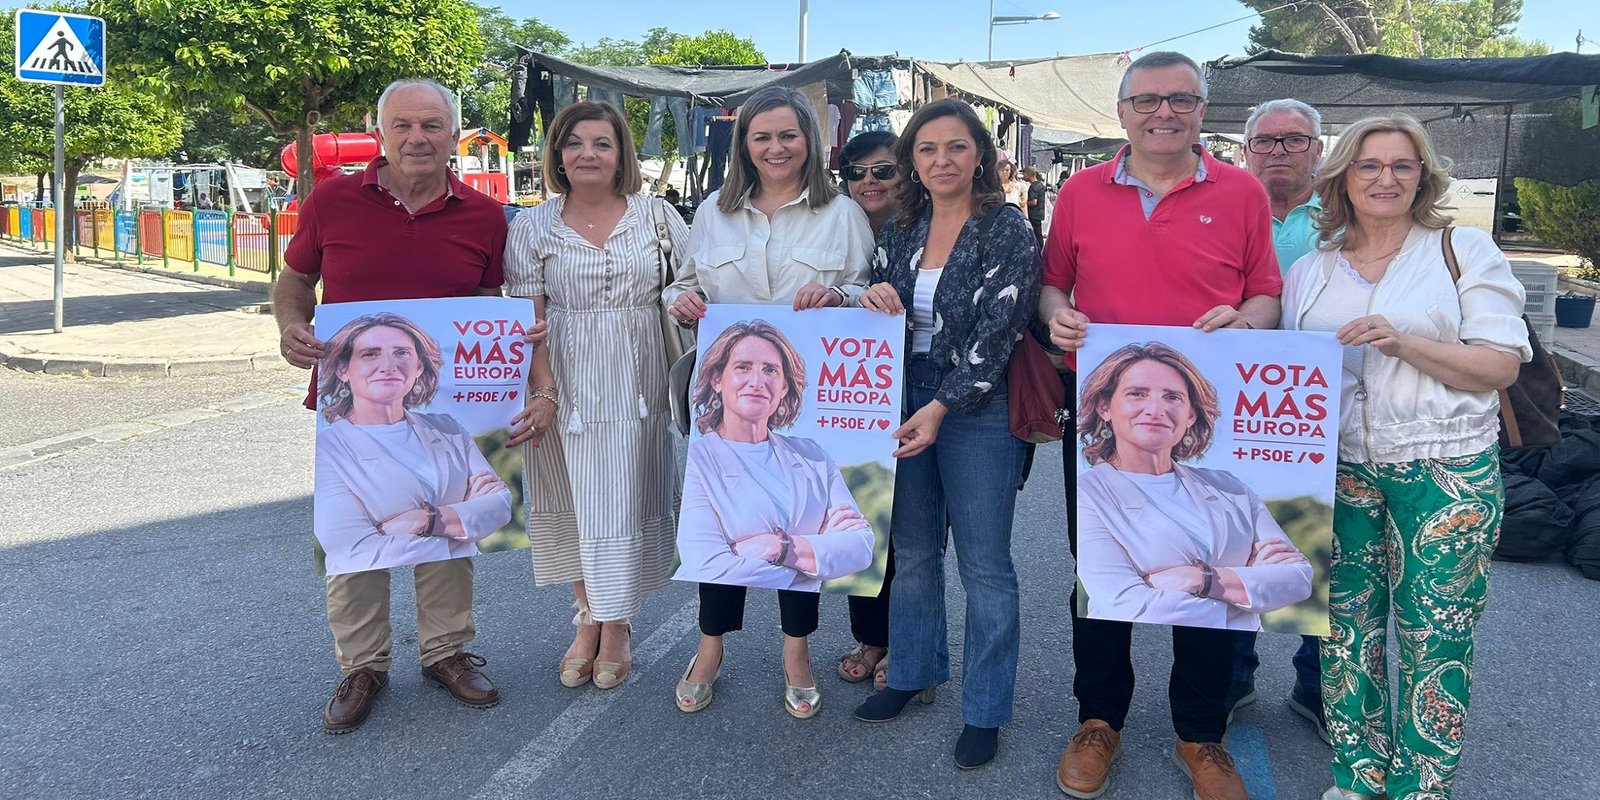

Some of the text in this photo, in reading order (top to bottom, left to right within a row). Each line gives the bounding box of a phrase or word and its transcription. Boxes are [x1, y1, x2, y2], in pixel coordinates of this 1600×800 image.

[452, 319, 527, 336] VOTA
[453, 335, 525, 365] MÁS
[820, 336, 894, 359] VOTA
[454, 366, 522, 379] EUROPA
[817, 357, 893, 390] MÁS
[1235, 362, 1329, 389] VOTA
[817, 388, 891, 406] EUROPA
[1233, 385, 1328, 421] MÁS
[1233, 419, 1326, 439] EUROPA
